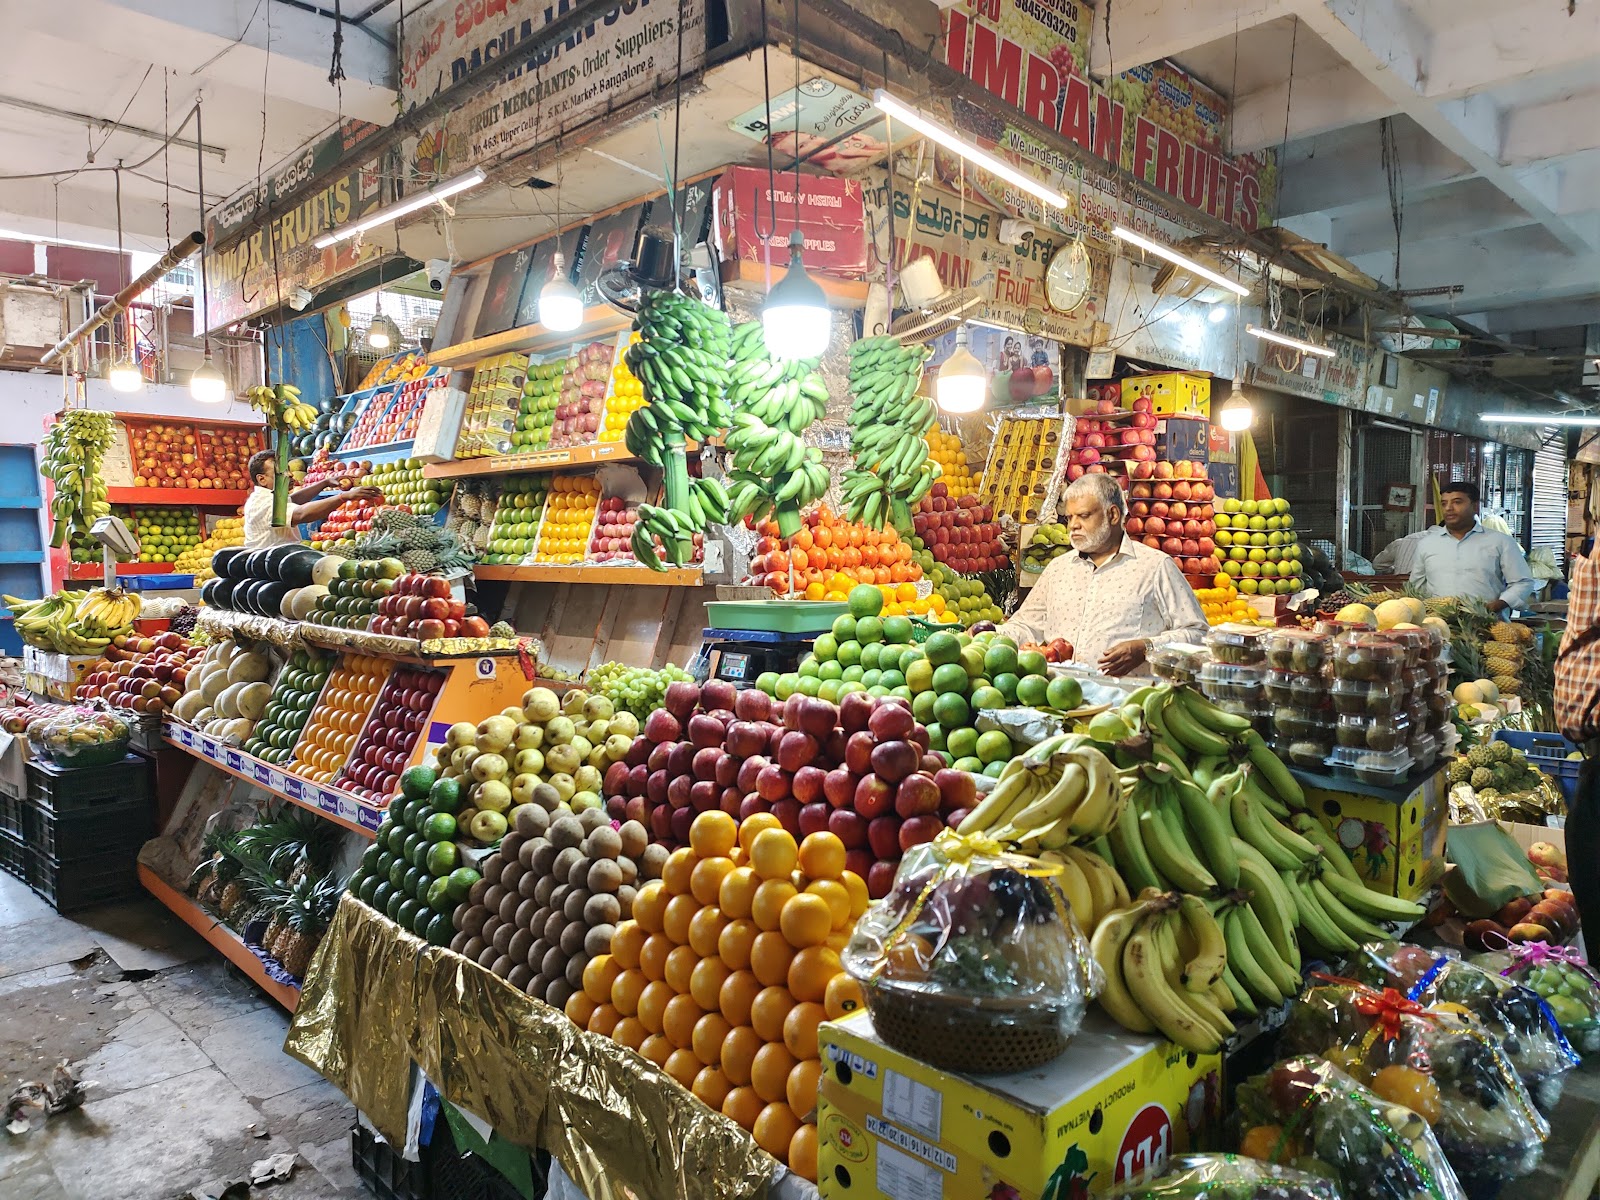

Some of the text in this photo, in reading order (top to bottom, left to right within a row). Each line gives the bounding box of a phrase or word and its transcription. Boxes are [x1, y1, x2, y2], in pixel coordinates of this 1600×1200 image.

[469, 104, 500, 136] FRUIT
[503, 65, 576, 119] MERCHANTS
[582, 49, 611, 78] Order
[500, 125, 521, 143] Upper
[835, 101, 871, 128] Tasty
[946, 8, 1261, 233] IMRAN FRUITS
[1010, 131, 1025, 151] We
[1028, 143, 1074, 175] undertake
[269, 176, 350, 260] FRUITS
[808, 194, 842, 208] FRESH
[1005, 190, 1026, 210] Shop
[1028, 200, 1041, 216] No.
[1067, 216, 1090, 234] Upper
[1080, 193, 1119, 224] Specialis
[1135, 217, 1149, 238] Gift
[995, 268, 1036, 308] FRUIT
[482, 661, 491, 673] पे
[1104, 1080, 1136, 1109] PRODUCT
[868, 1119, 955, 1169] 24 22 20 18 16 14 12 10
[1057, 1110, 1091, 1138] VIETNAM
